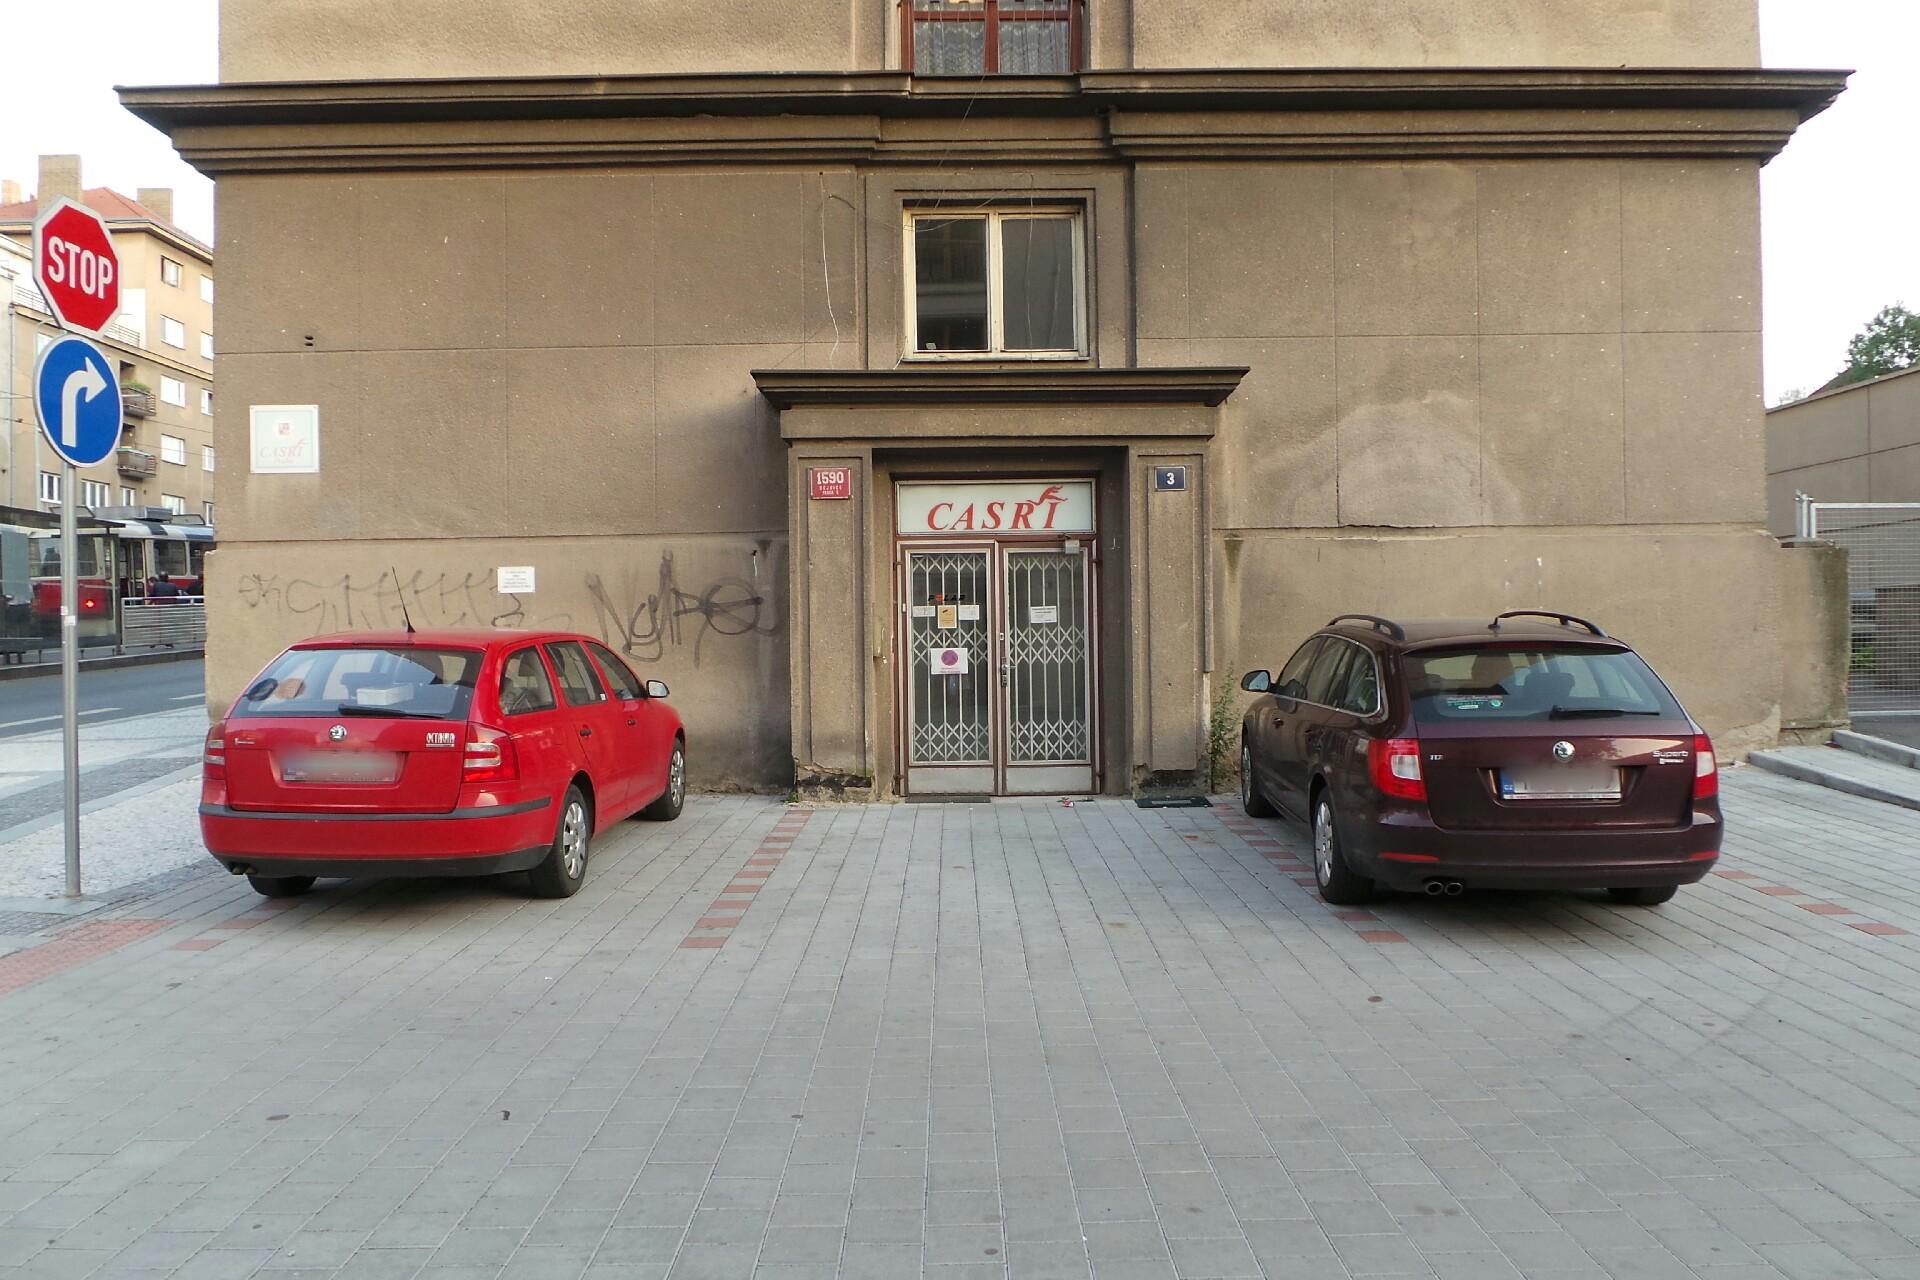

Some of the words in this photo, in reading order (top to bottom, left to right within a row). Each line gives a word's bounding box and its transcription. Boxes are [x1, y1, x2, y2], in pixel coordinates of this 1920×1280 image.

[48, 236, 113, 299] STOP
[817, 472, 844, 484] 1590
[1167, 472, 1174, 484] 3
[927, 501, 1061, 530] CASRI
